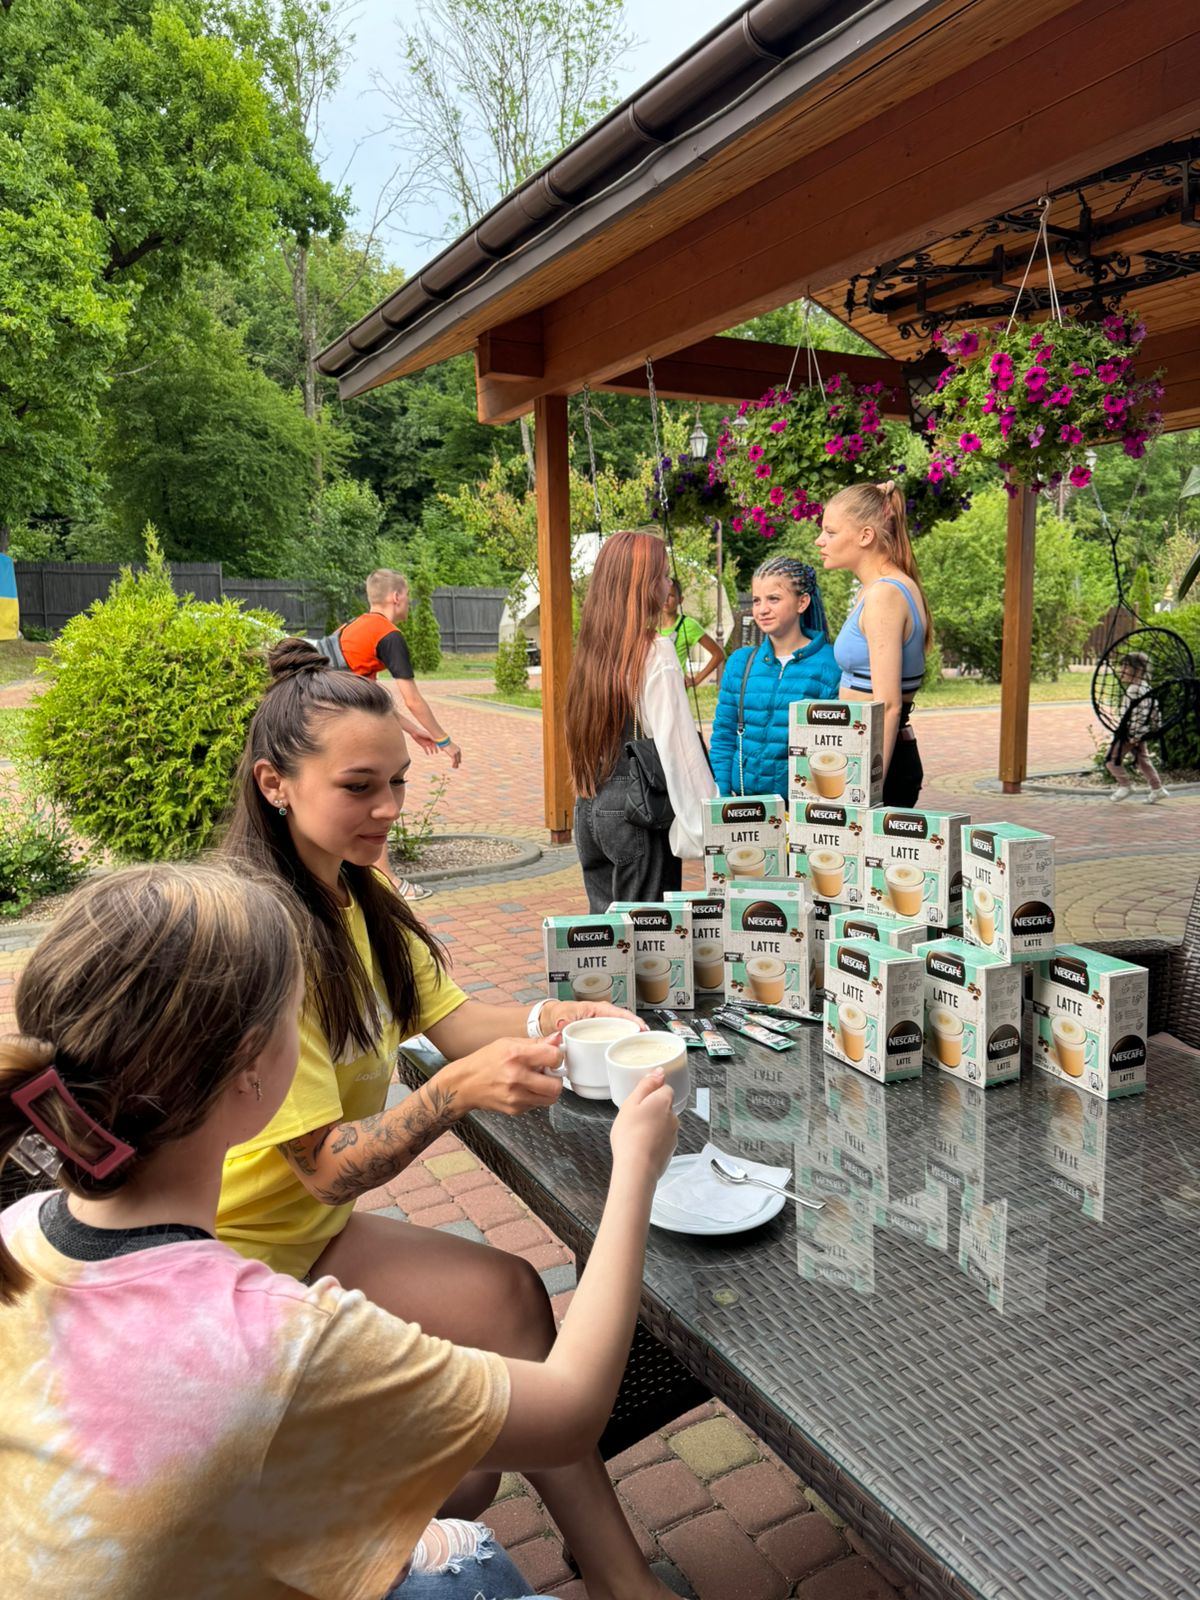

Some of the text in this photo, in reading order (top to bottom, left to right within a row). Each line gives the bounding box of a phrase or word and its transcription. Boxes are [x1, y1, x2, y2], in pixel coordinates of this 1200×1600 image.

[812, 708, 847, 720] NESCAFÉ
[815, 734, 842, 746] LATTE
[727, 806, 762, 817] NESCAFÉ
[810, 807, 843, 821] NESCAFÉ
[888, 820, 924, 832] NESCAFÉ
[731, 831, 760, 842] LATTE
[813, 833, 840, 846] LATTE
[891, 846, 920, 860] LATTE
[975, 866, 992, 885] LATTE
[633, 914, 668, 926] NESCAFÉ
[748, 917, 784, 927] NESCAFÉ
[1014, 912, 1053, 927] NESCAFÉ
[573, 929, 610, 942] NESCAFÉ
[692, 928, 720, 939] LATTE
[636, 940, 665, 951] LATTE
[751, 940, 780, 953] LATTE
[1024, 938, 1042, 947] LATTE
[577, 956, 607, 968] LATTE
[841, 955, 868, 973] NESCAFÉ
[930, 958, 963, 978] NESCAFÉ
[1054, 965, 1087, 986] NESCAFÉ
[843, 981, 864, 1003] LATTE
[933, 987, 959, 1009] LATTE
[1057, 994, 1083, 1017] LATTE
[889, 1031, 921, 1047] NESCAFÉ
[989, 1037, 1019, 1052] NESCAFÉ
[1112, 1046, 1144, 1063] NESCAFÉ
[896, 1057, 912, 1066] LATTE
[997, 1061, 1011, 1071] LATTE
[1120, 1072, 1135, 1083] LATTE
